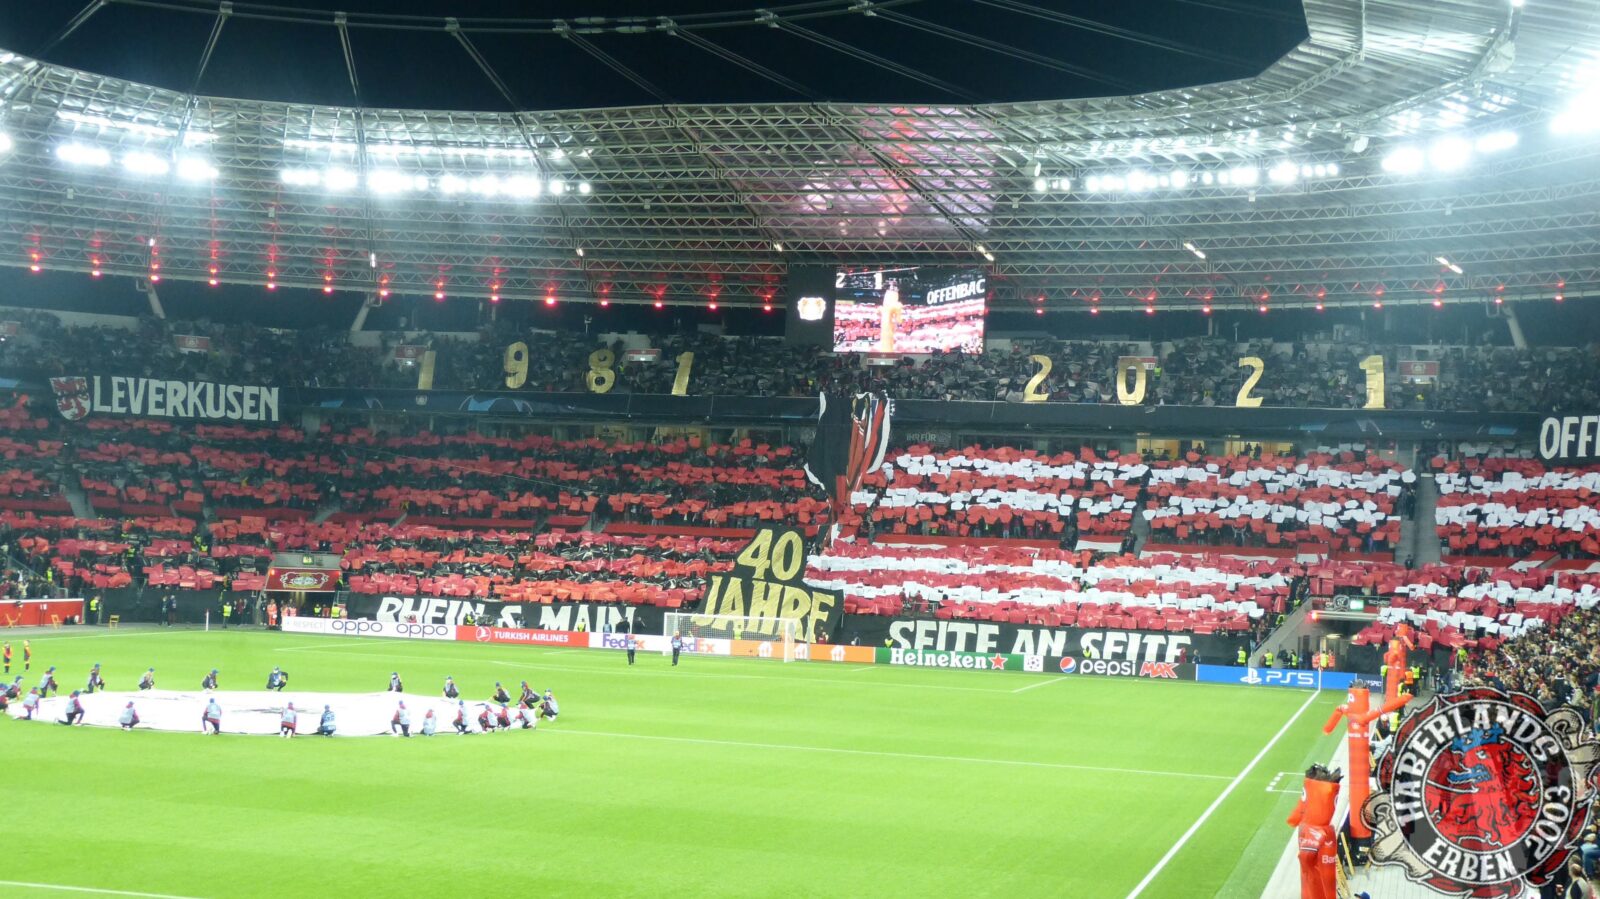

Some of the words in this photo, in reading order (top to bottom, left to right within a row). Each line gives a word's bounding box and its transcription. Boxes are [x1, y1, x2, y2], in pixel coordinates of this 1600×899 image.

[926, 278, 986, 305] OFFENBAC
[503, 341, 529, 389] 9
[586, 349, 616, 393] 8
[671, 351, 694, 395] 1
[1023, 355, 1053, 402] 2
[1117, 357, 1146, 405] 0
[1235, 356, 1264, 408] 2
[1358, 355, 1386, 409] 1
[93, 375, 279, 422] LEVERKUSEN
[737, 528, 803, 581] 40
[539, 603, 637, 633] MAIN
[691, 575, 835, 643] JAHRE
[331, 620, 383, 635] oppo
[396, 623, 448, 638] oppo
[494, 631, 530, 640] TURKISH
[531, 632, 569, 643] AIRLINES
[889, 619, 999, 653] SEITE
[1011, 628, 1067, 657] AN
[1080, 630, 1192, 663] SEITE
[890, 648, 988, 669] Heineken
[1080, 659, 1136, 676] pepsi
[1139, 661, 1179, 679] MAX
[1265, 671, 1314, 685] PS5
